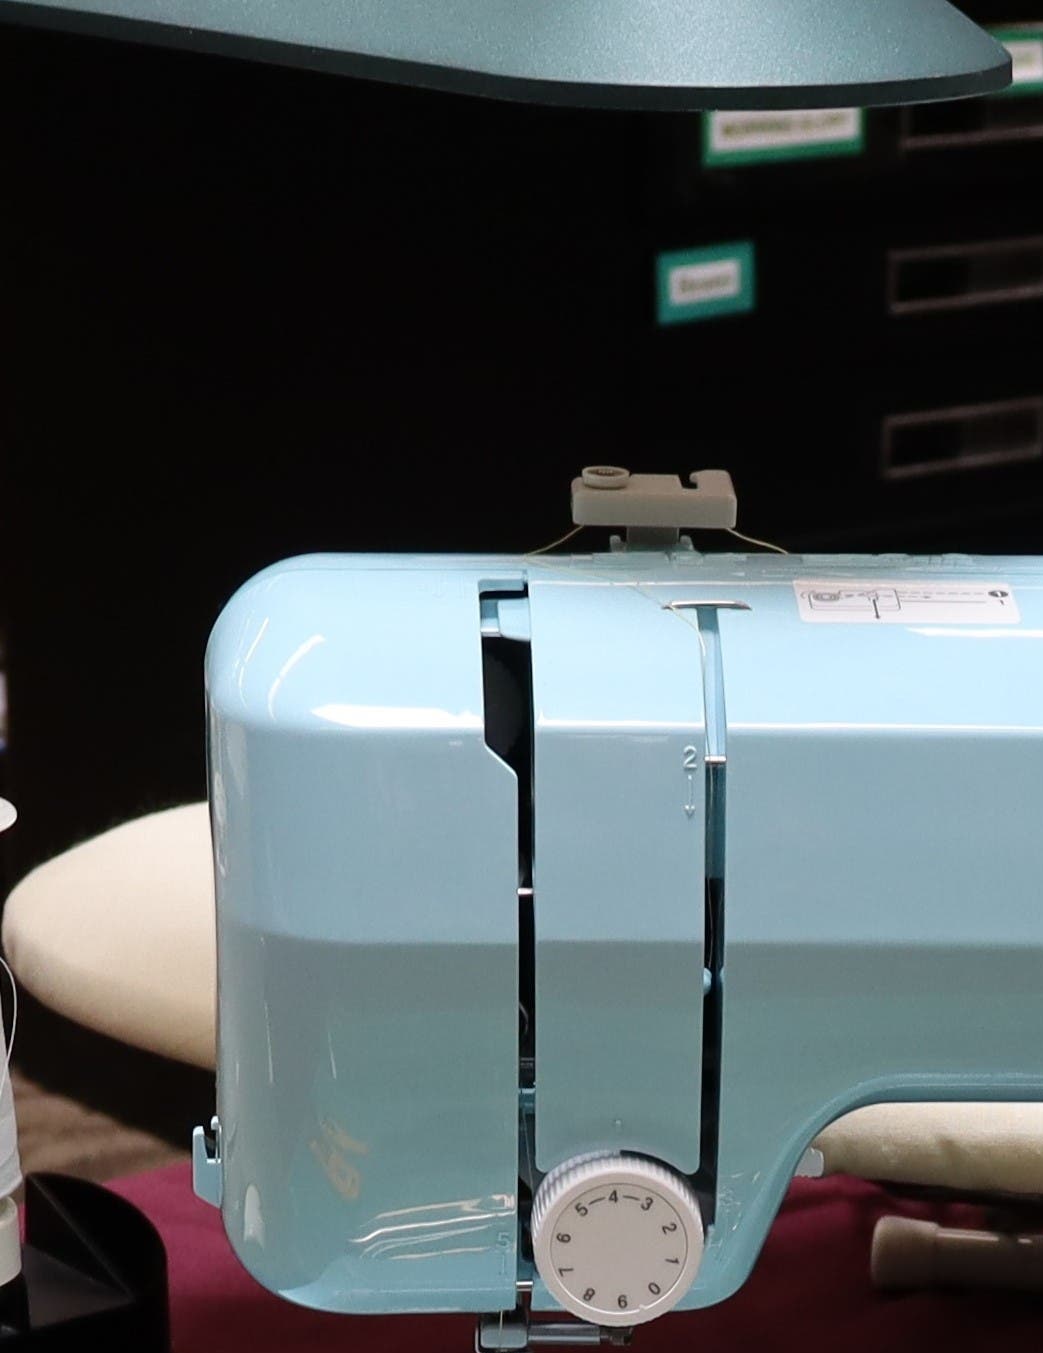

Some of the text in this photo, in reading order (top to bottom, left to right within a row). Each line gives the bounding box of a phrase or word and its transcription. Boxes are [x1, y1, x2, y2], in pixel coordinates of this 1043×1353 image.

[683, 745, 698, 769] 2
[608, 1189, 618, 1204] 4
[575, 1202, 589, 1217] 5
[641, 1197, 654, 1211] 3
[662, 1222, 677, 1235] 2
[665, 1256, 679, 1265] 1
[558, 1267, 574, 1277] 7
[583, 1287, 596, 1302] 8
[648, 1282, 661, 1296] 0
